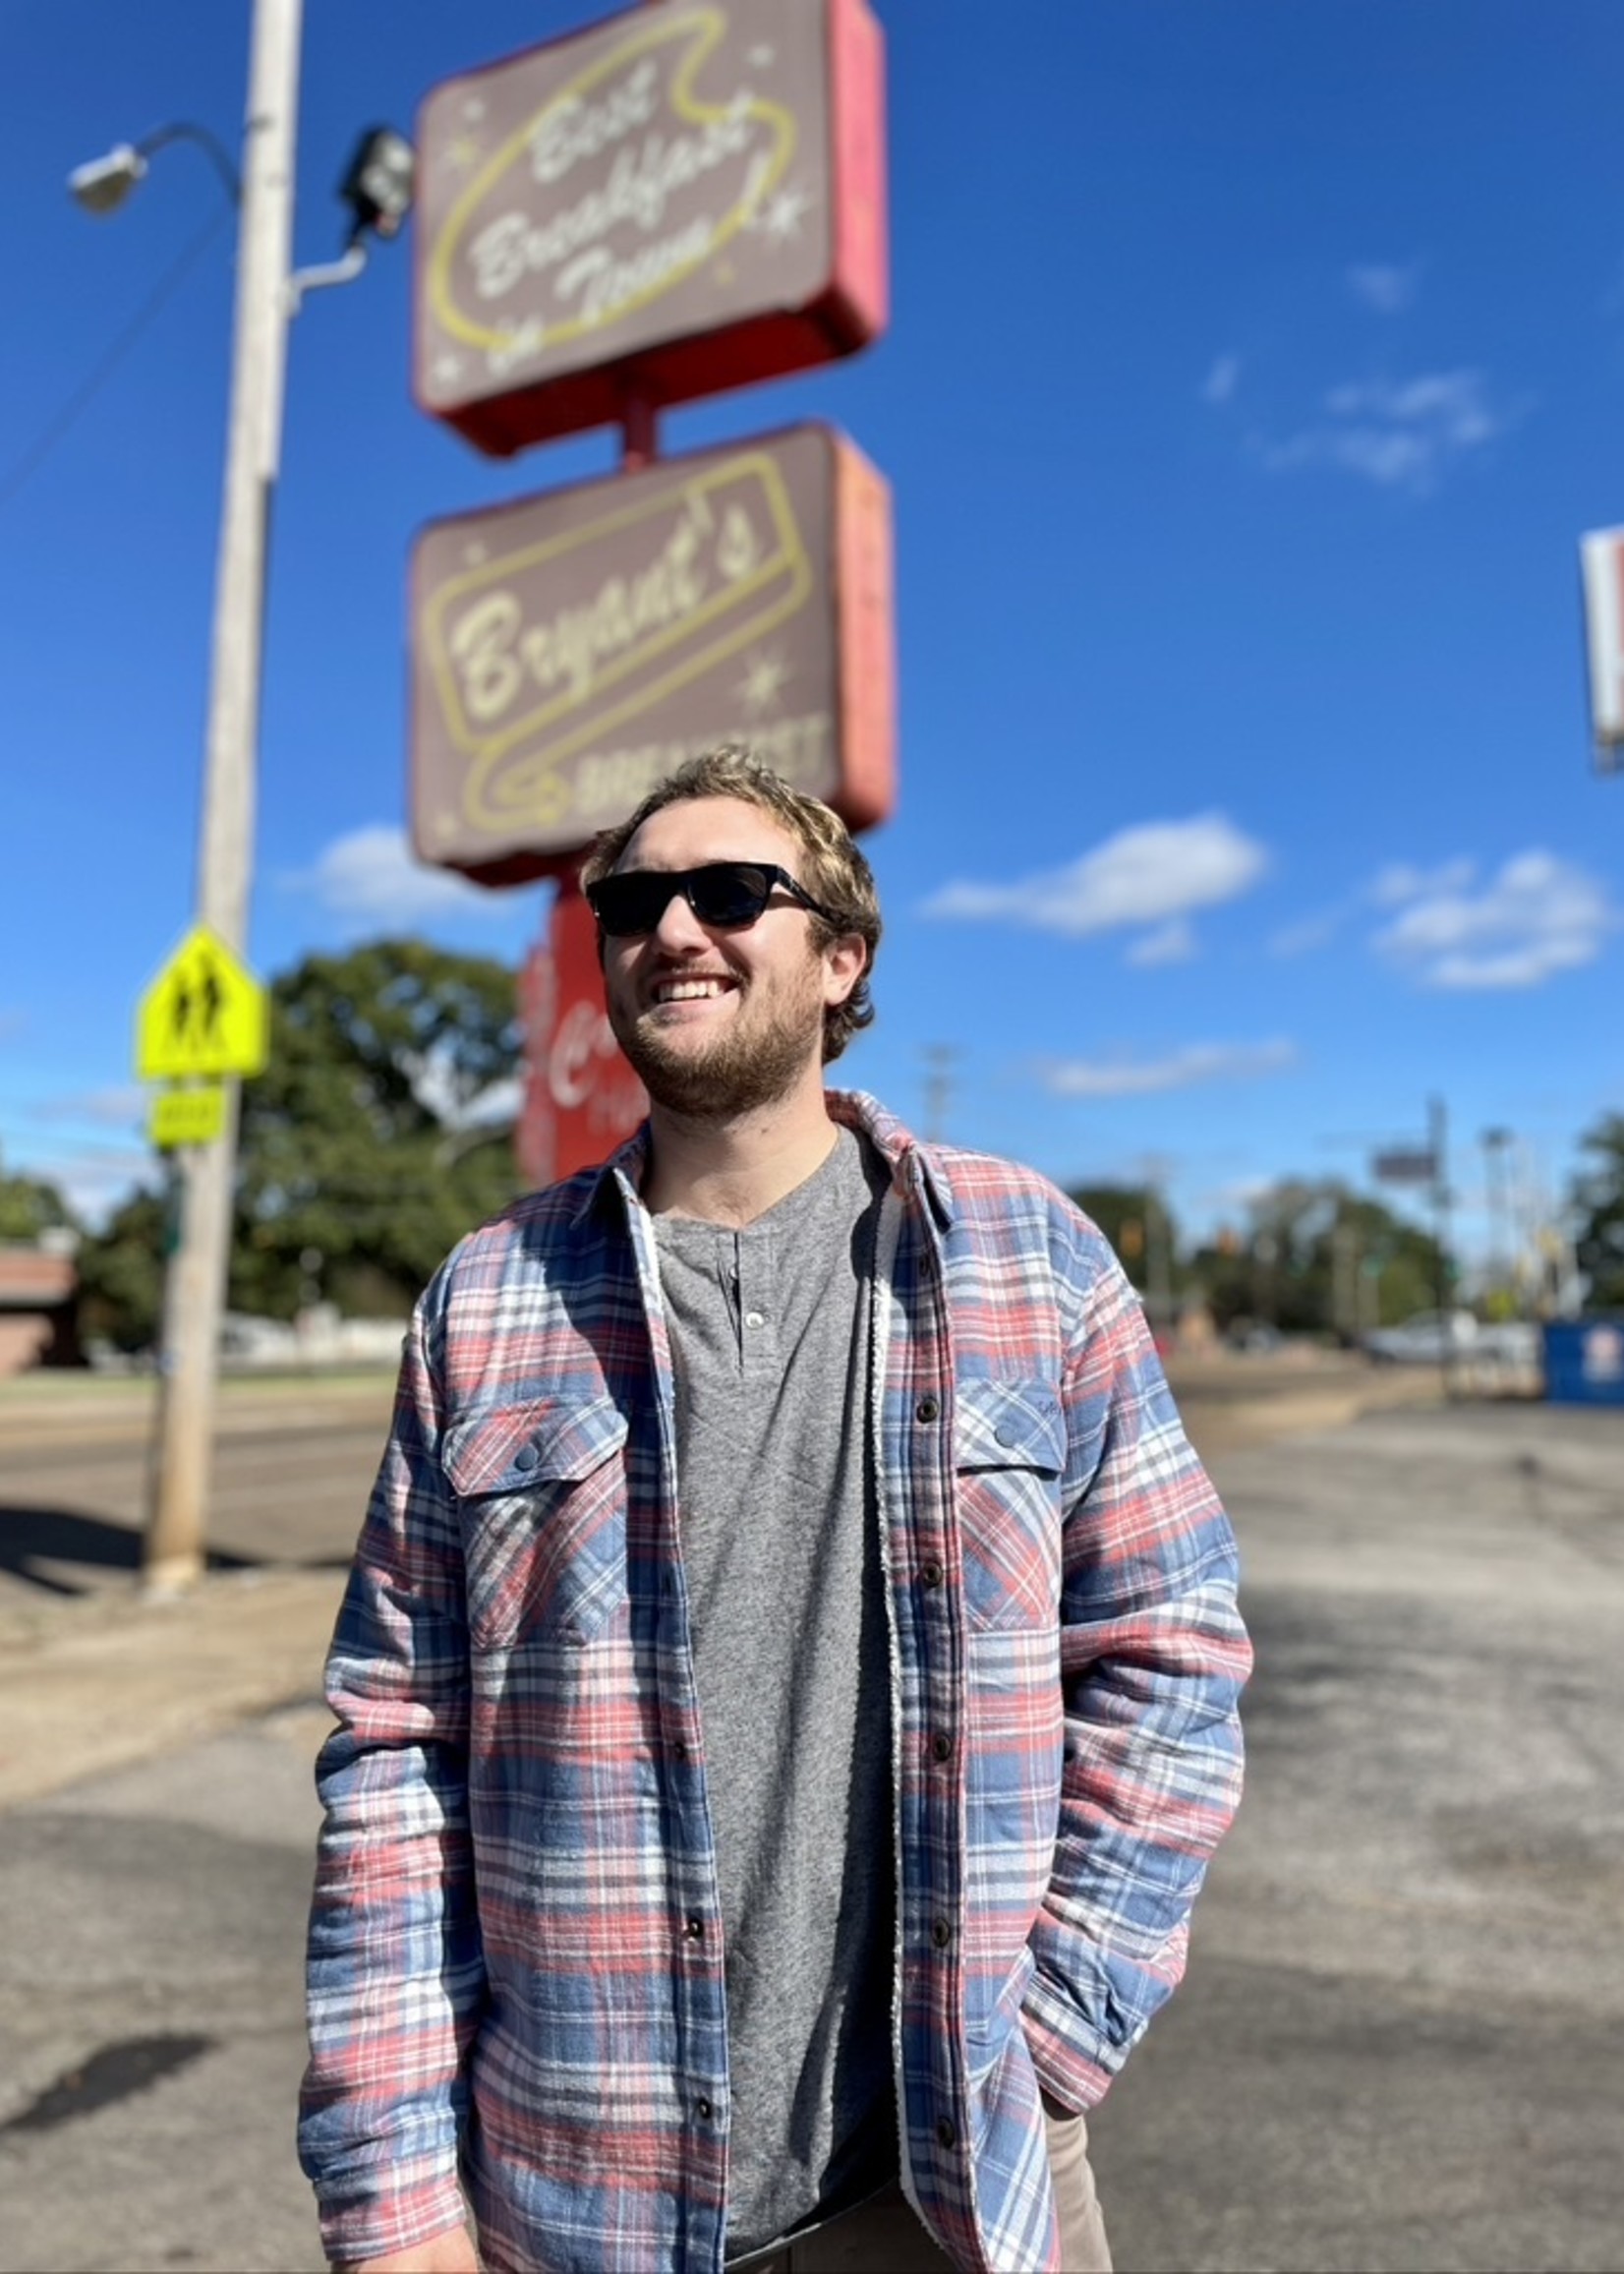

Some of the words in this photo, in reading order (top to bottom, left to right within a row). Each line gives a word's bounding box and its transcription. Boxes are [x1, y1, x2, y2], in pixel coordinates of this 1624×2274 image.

[468, 85, 755, 299] Breakfast
[531, 59, 657, 184] Best
[450, 487, 760, 723] Bryant's
